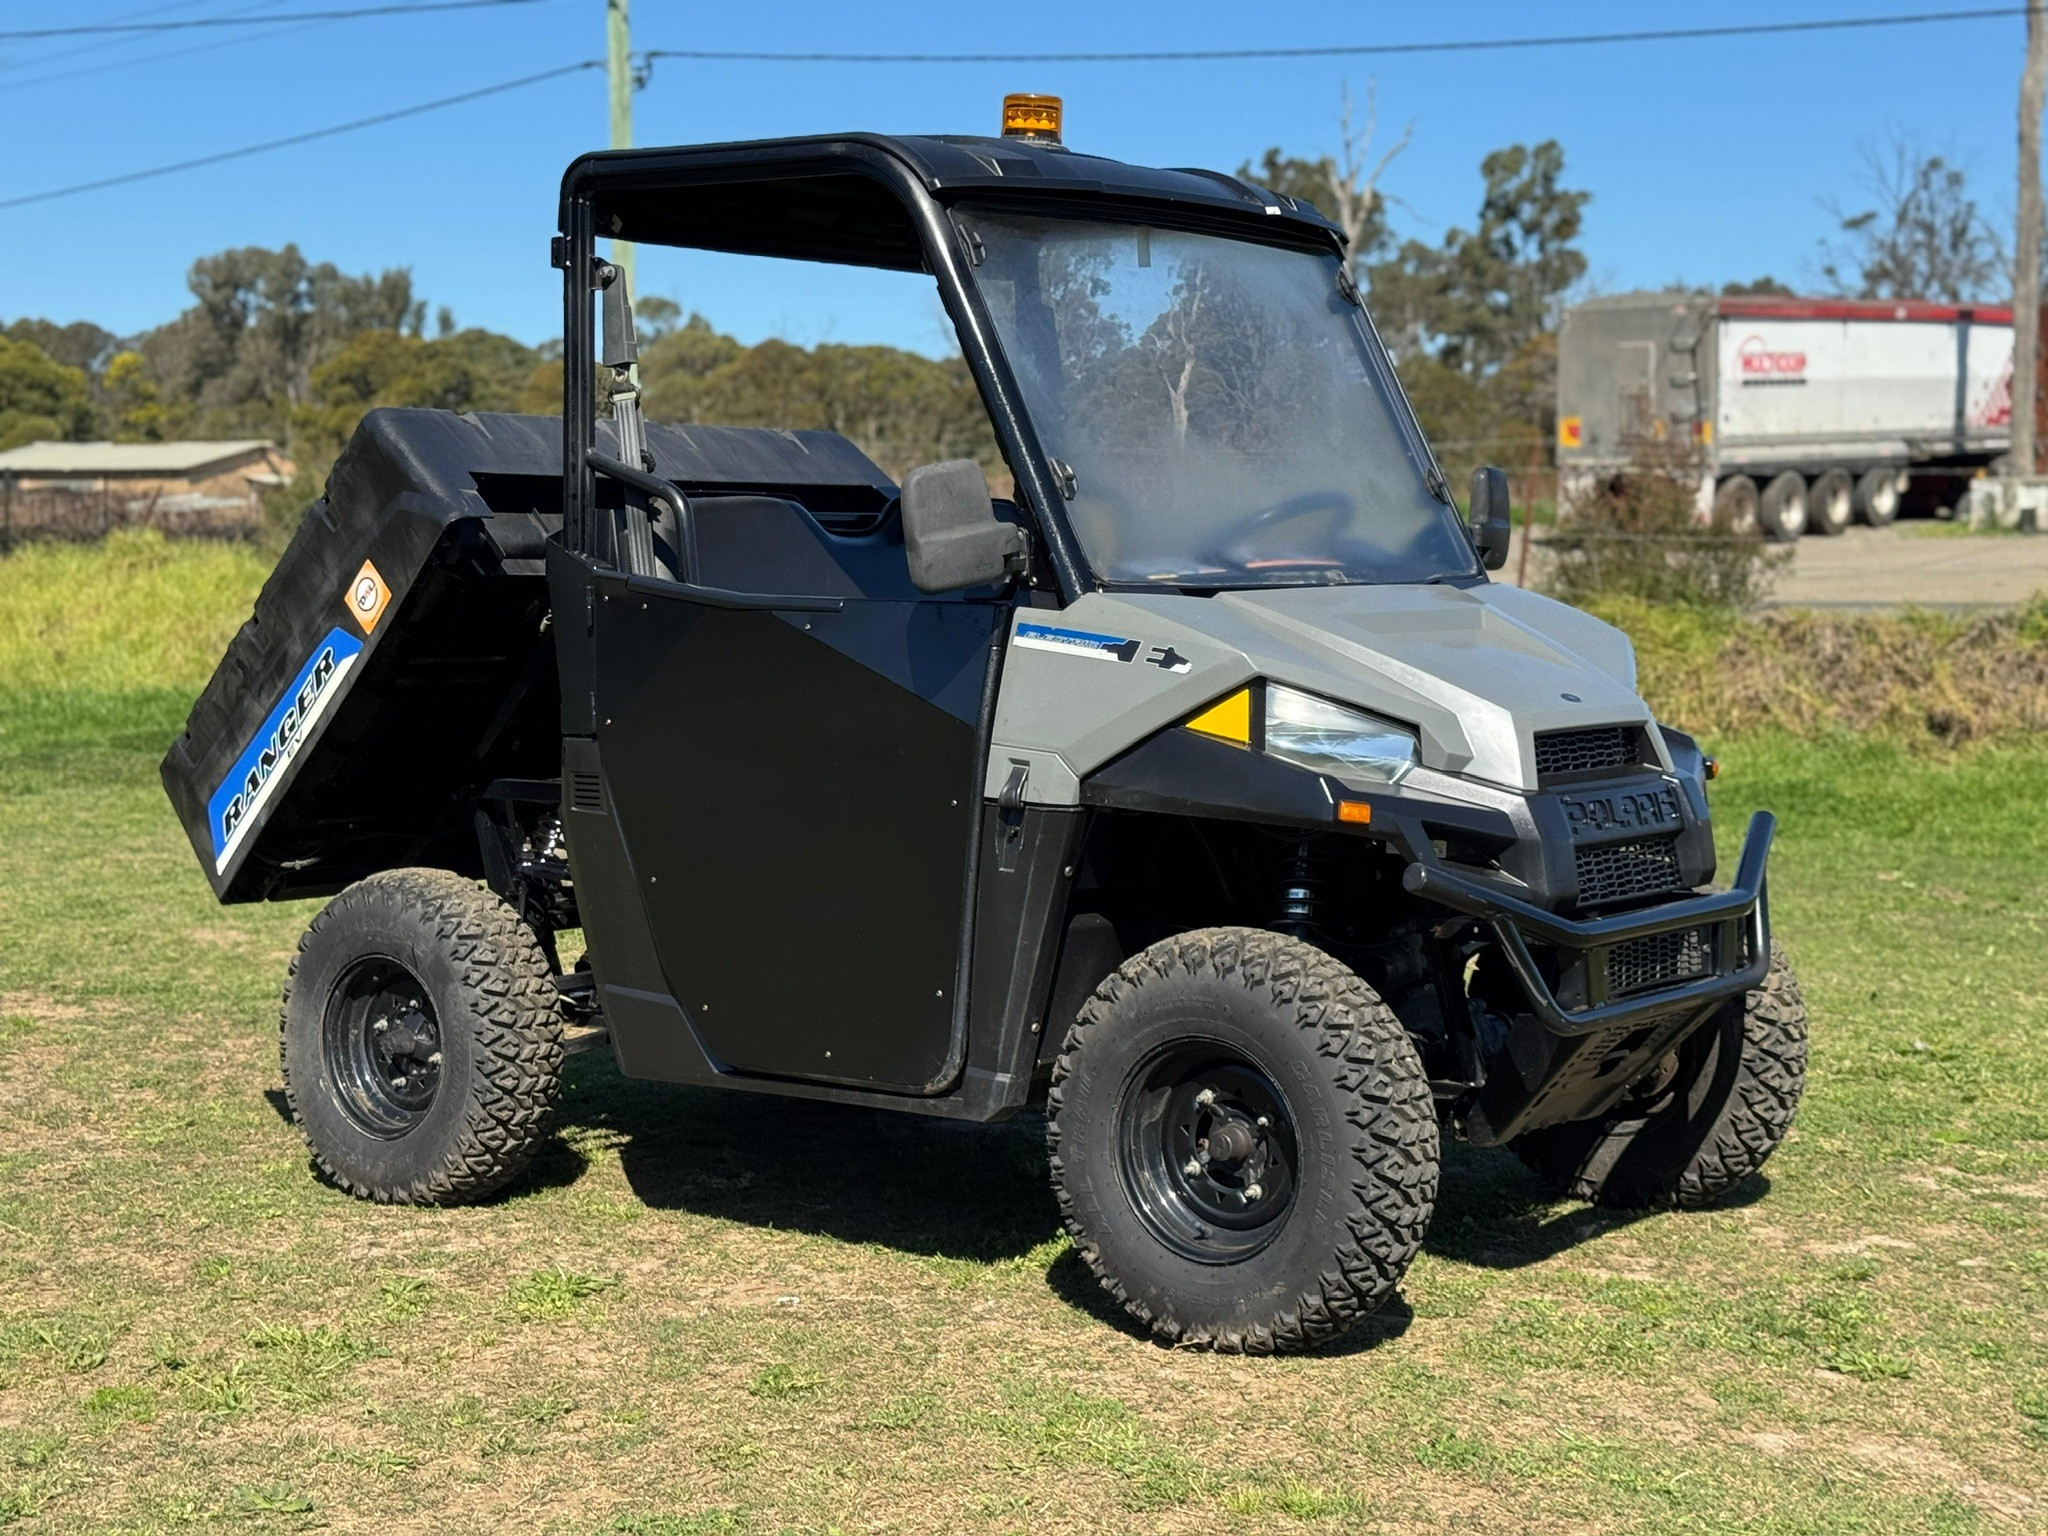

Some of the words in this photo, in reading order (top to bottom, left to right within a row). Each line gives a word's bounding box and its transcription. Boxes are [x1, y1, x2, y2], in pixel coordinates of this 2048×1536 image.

[223, 646, 337, 842] RANGER
[287, 731, 304, 758] EV
[1564, 788, 1678, 836] POLARIS
